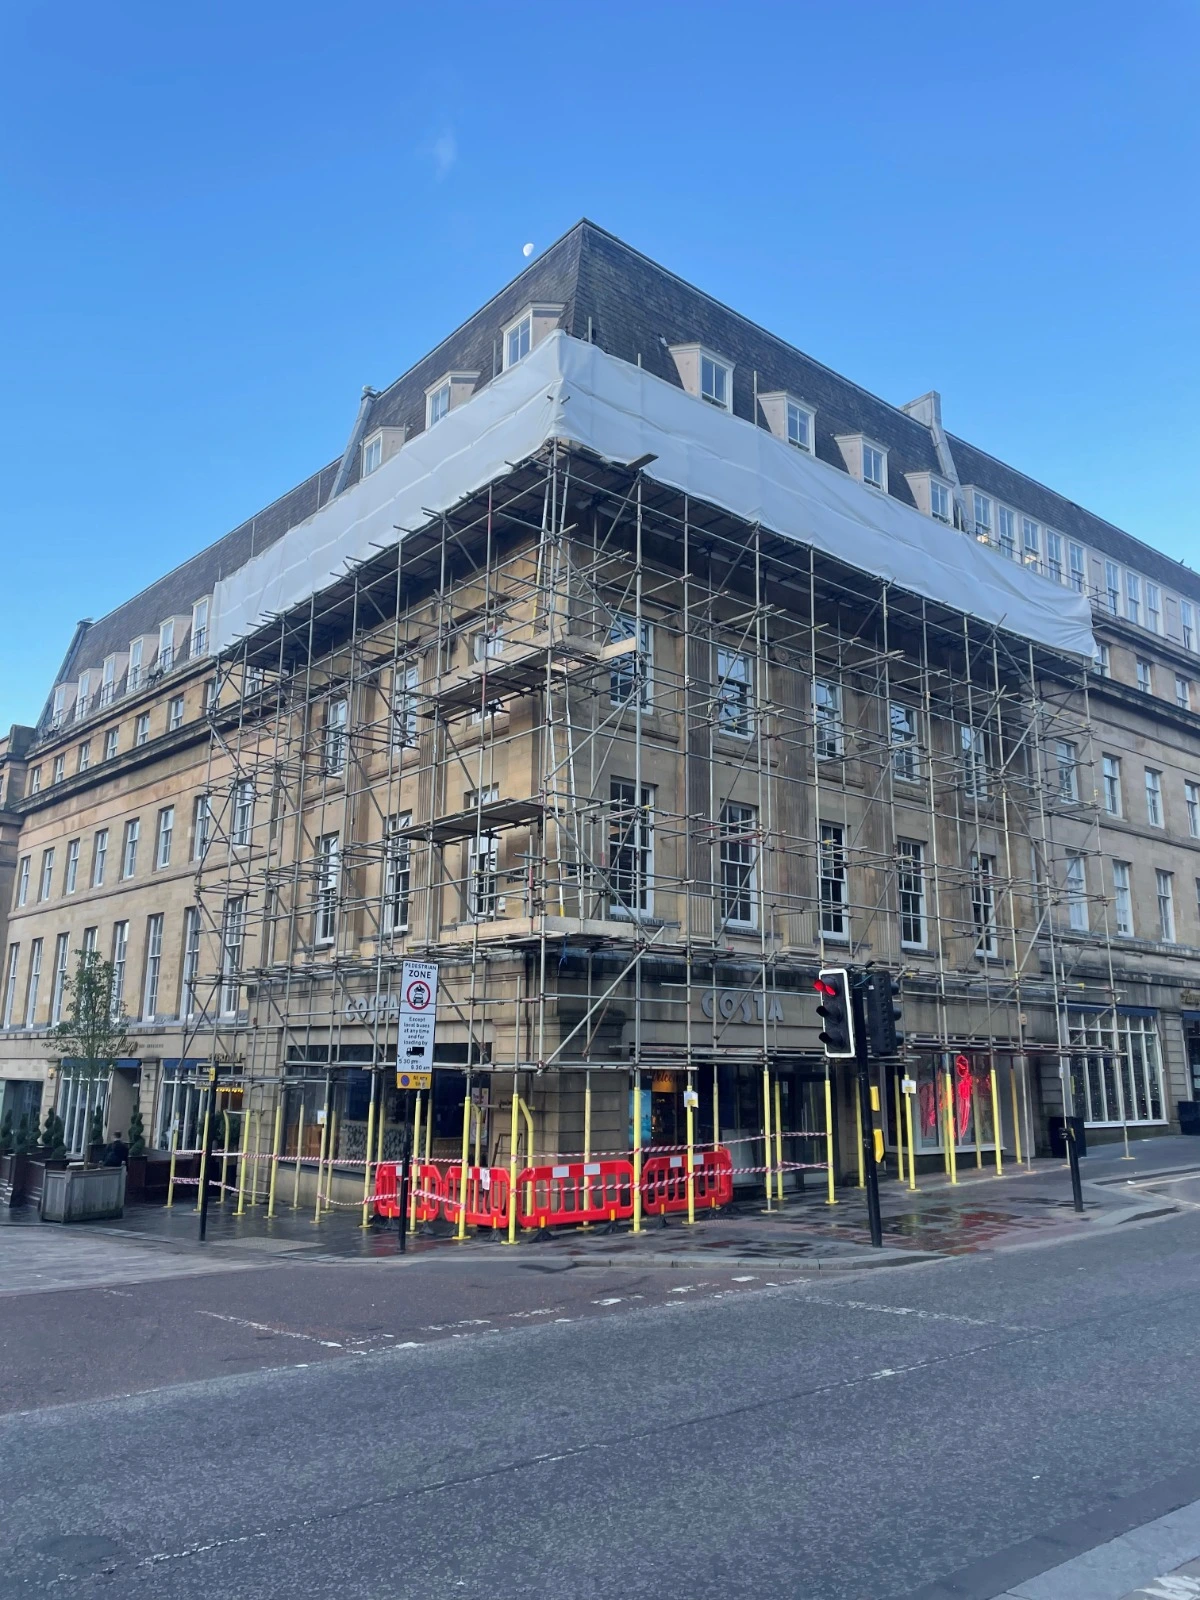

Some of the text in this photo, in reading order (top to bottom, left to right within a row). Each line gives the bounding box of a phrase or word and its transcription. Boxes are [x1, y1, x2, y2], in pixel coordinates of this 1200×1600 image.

[405, 962, 437, 971] PEDESTRIAN
[409, 969, 432, 979] ZONE
[344, 994, 399, 1024] COSTA
[701, 989, 784, 1024] COSTA
